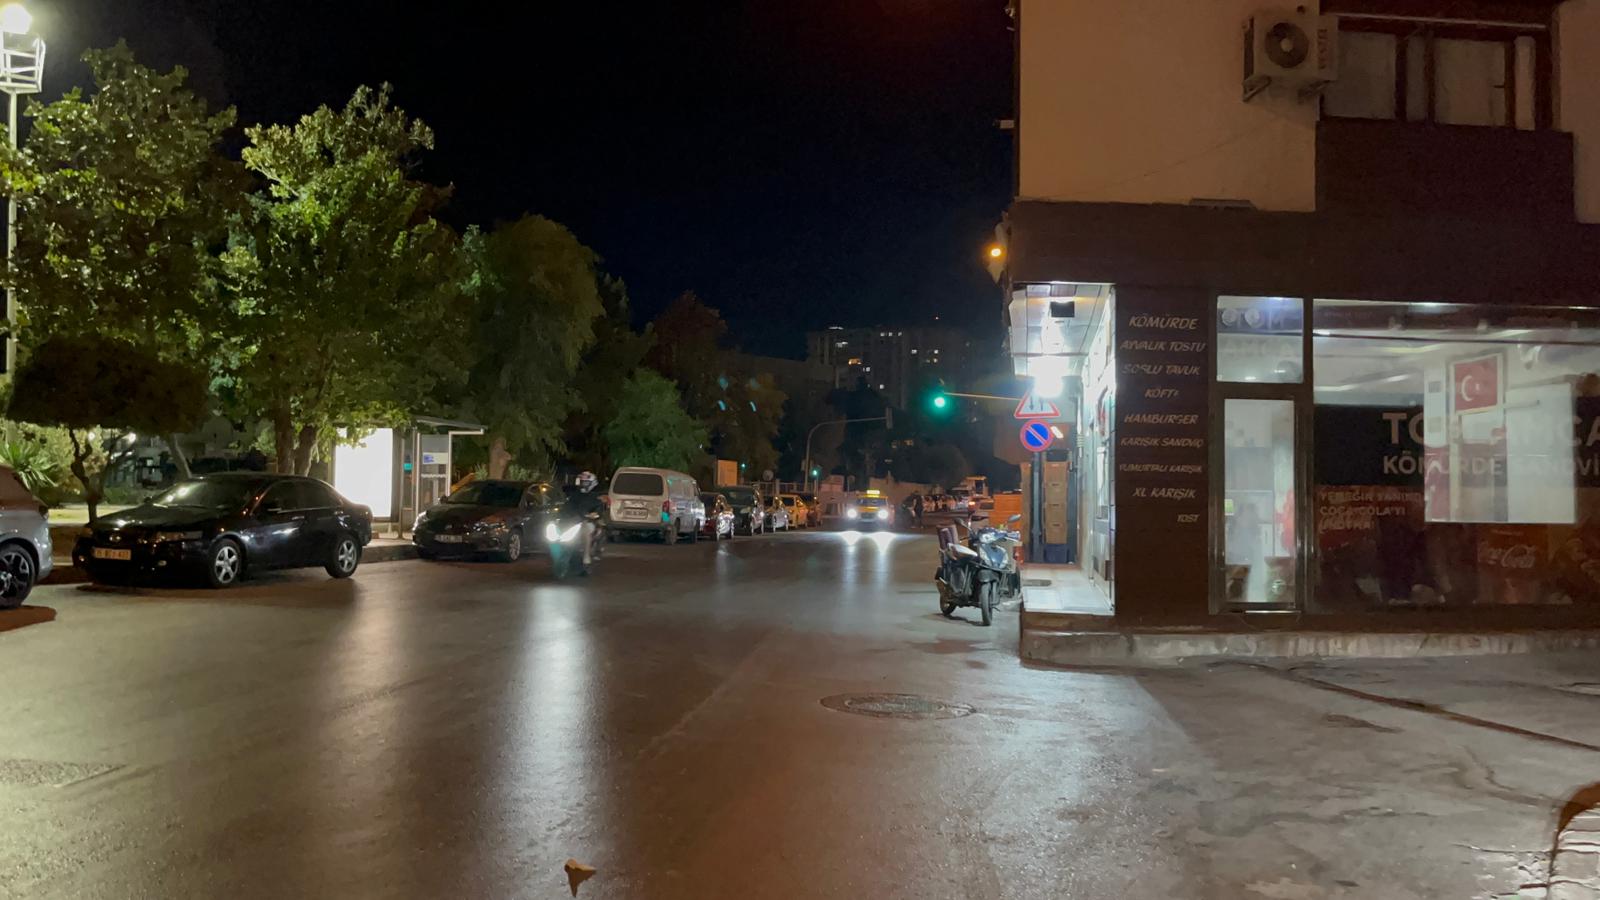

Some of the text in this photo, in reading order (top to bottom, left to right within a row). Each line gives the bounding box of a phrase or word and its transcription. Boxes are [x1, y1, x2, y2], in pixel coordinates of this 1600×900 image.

[1129, 314, 1199, 330] KÖMÜRDE
[1120, 340, 1206, 352] AYVALIK TOSTU
[1121, 363, 1200, 376] SOSLU TAVUK
[1124, 414, 1199, 425] HAMBURGER
[1132, 487, 1197, 501] XL KARIŞIK
